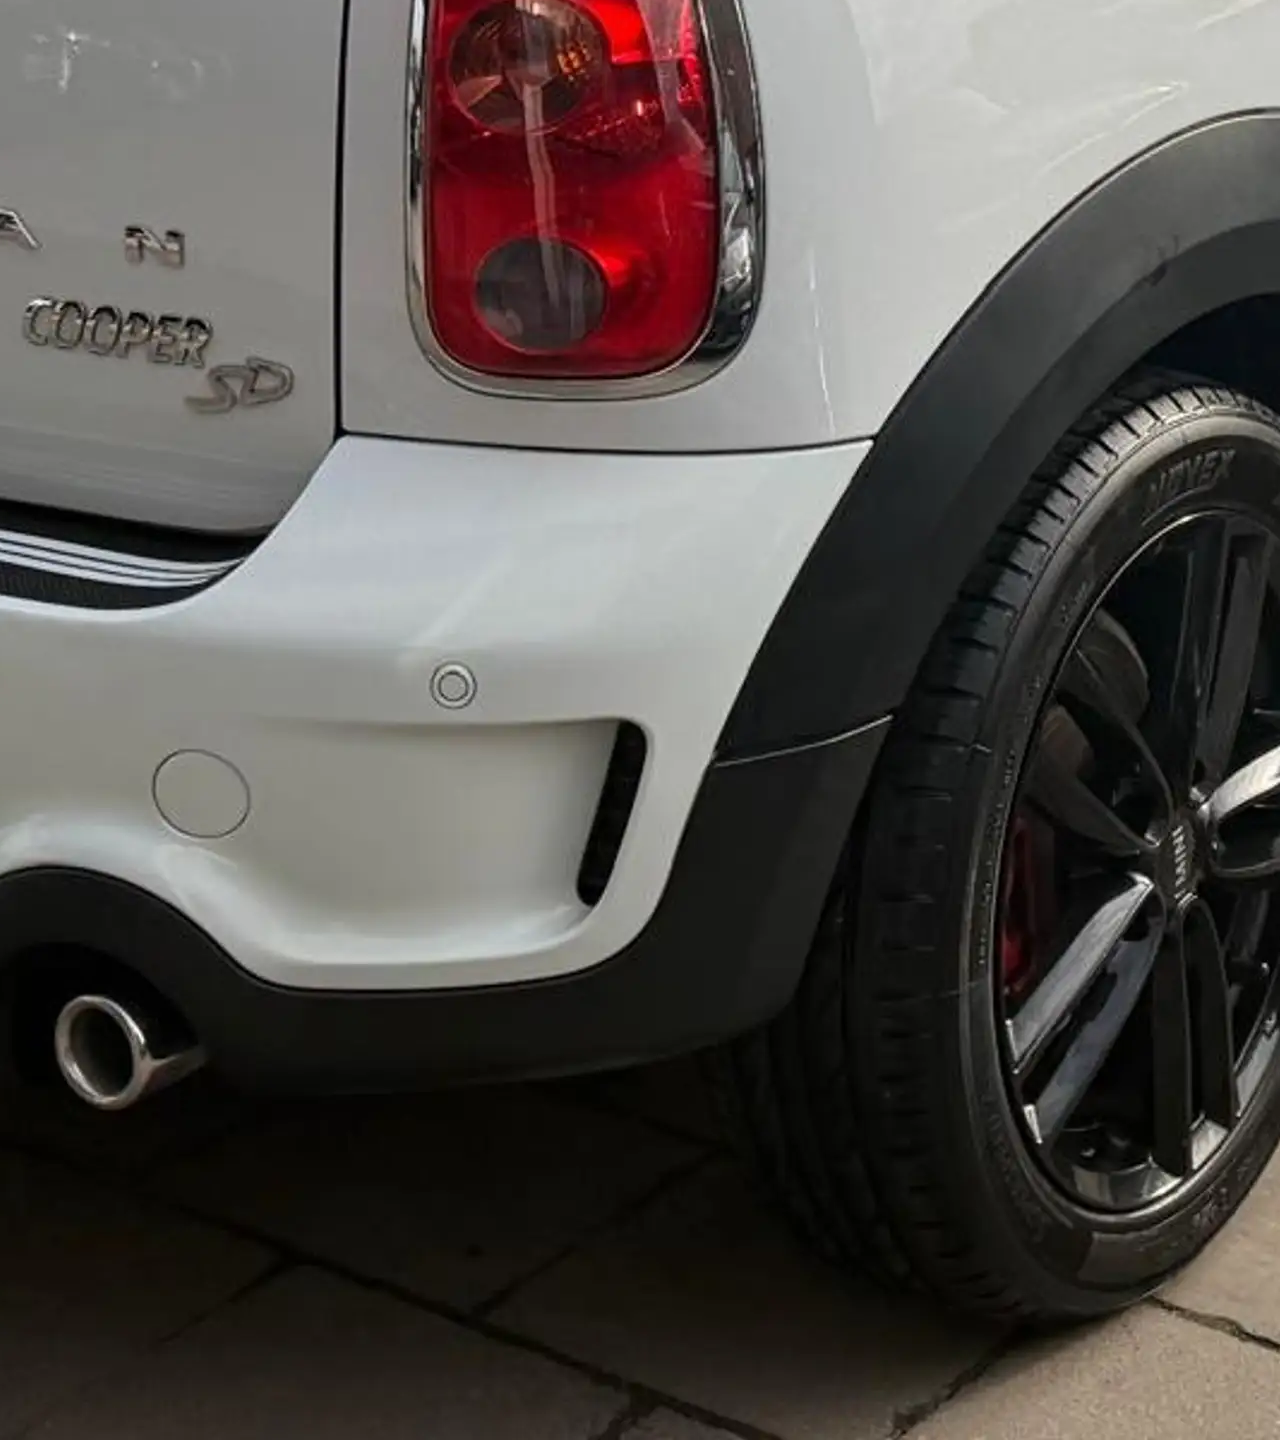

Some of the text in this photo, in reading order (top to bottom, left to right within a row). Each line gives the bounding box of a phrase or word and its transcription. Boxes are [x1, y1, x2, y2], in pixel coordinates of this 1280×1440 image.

[21, 295, 215, 371] COOPER
[184, 356, 296, 415] SD
[1144, 448, 1238, 511] NOVEX
